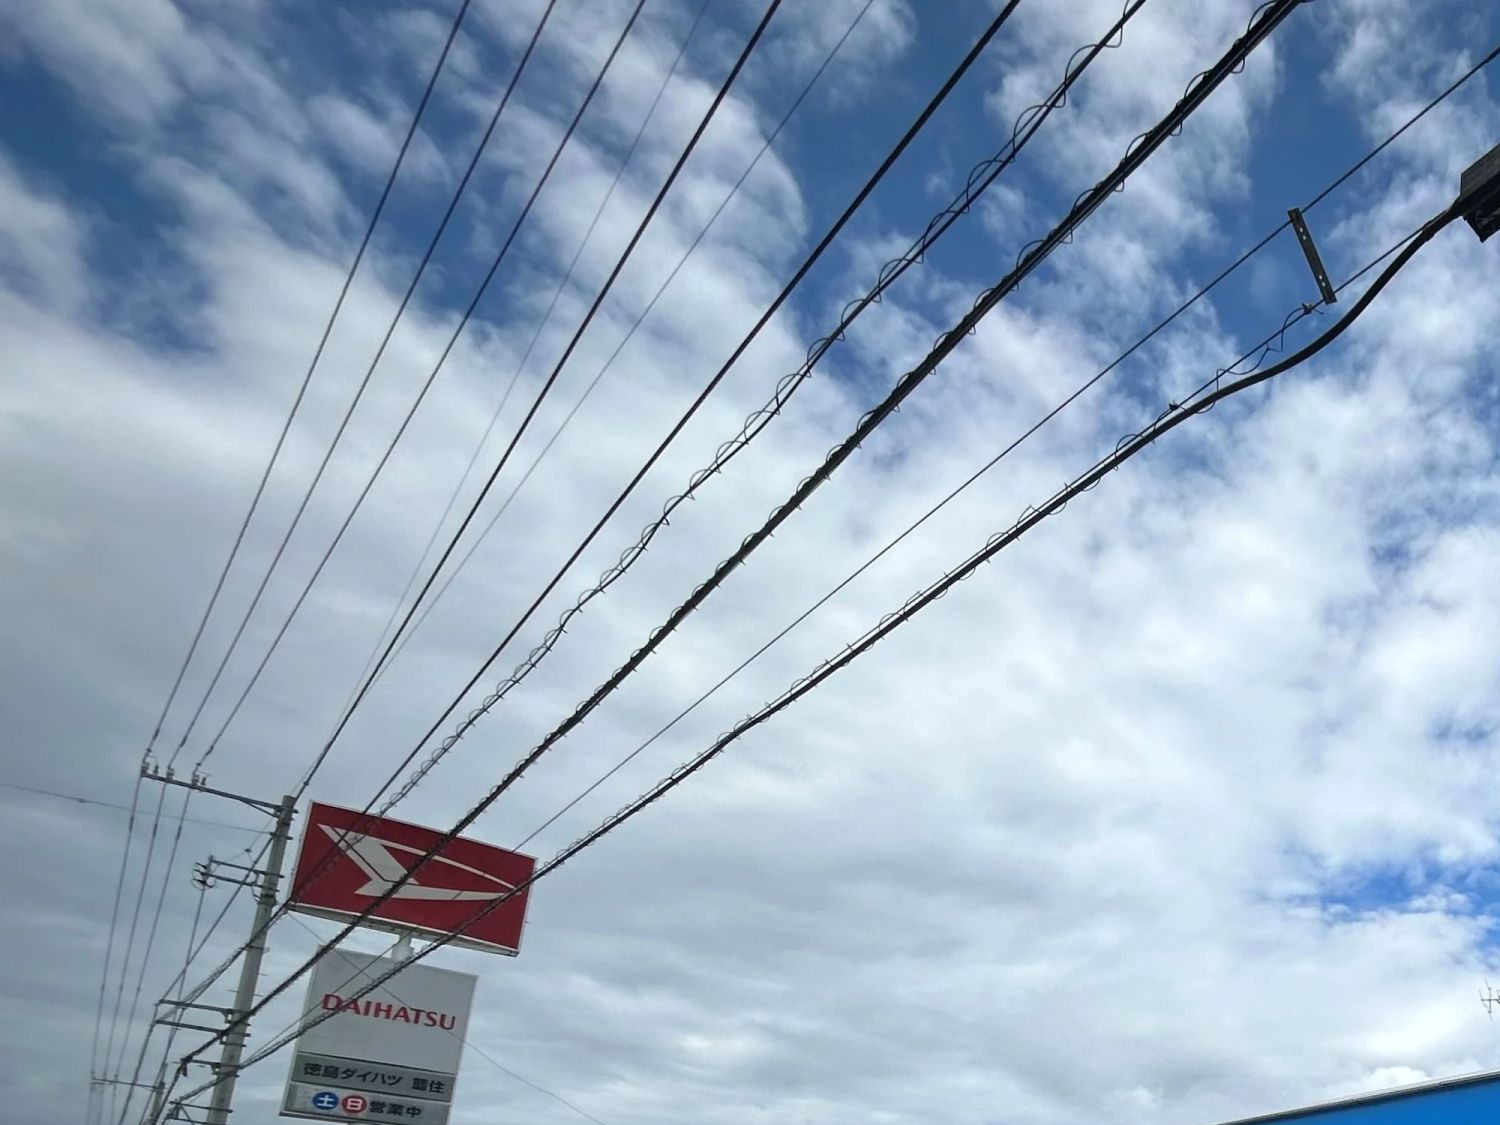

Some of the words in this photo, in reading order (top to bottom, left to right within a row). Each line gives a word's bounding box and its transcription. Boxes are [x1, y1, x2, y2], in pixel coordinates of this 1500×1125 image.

[322, 993, 456, 1031] DAIHATSU
[303, 1062, 403, 1086] 徳島ダイハツ
[412, 1077, 446, 1094] 藍住
